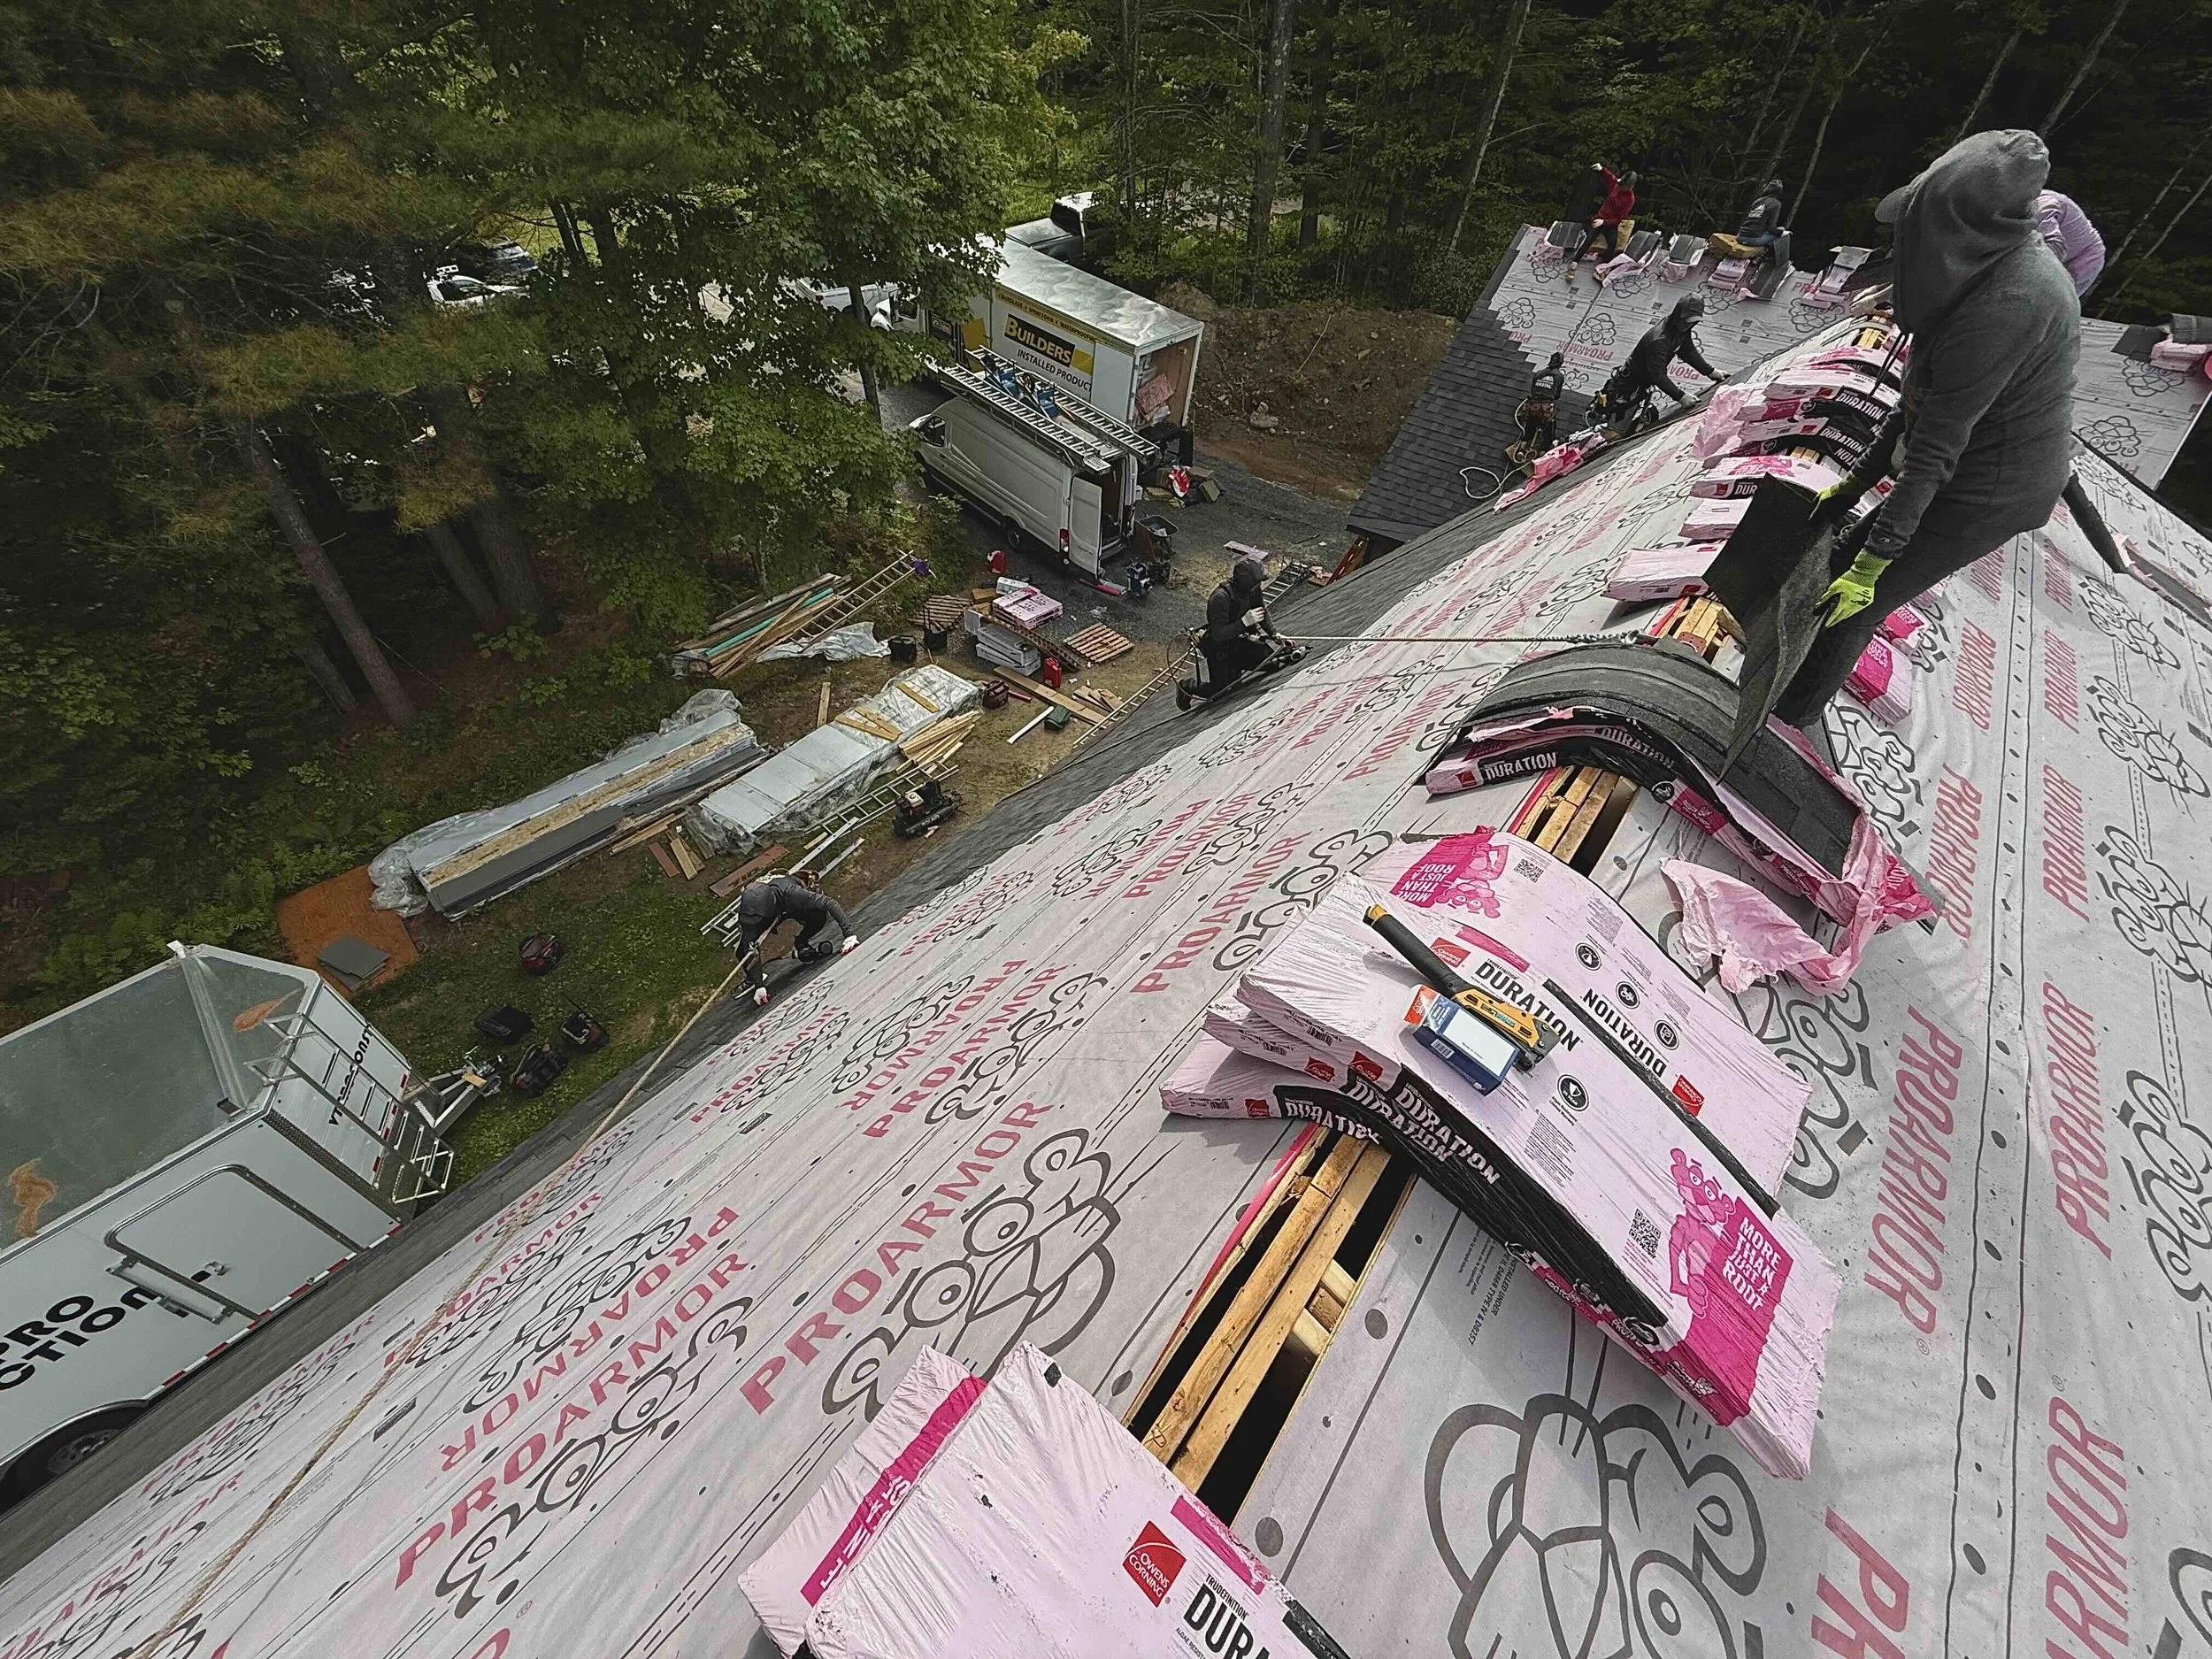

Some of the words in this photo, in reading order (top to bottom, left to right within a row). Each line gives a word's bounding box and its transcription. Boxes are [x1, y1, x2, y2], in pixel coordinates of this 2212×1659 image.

[1007, 317, 1072, 365] BUILDERS
[1018, 349, 1056, 373] INSTALLED
[1835, 393, 1886, 421] DURATION
[1402, 881, 1440, 892] THAN
[1417, 864, 1456, 873] ROOF
[1428, 872, 1447, 882] JUST
[1132, 832, 1311, 994] PROARMOR
[1396, 892, 1432, 902] MORE
[1475, 961, 1580, 1052] DURATION
[1582, 987, 1668, 1079] DURATION
[841, 960, 1026, 1111] PROARMOR
[862, 965, 1069, 1138] PROARMOR
[1345, 1081, 1454, 1162] DURATION
[1394, 1087, 1502, 1185] DURATION
[2043, 982, 2112, 1261] PROARMOR
[1863, 1004, 1963, 1333] PROARMOR
[740, 1100, 1054, 1415] PROARMOR
[1737, 1233, 1775, 1289] THAN
[1740, 1217, 1782, 1270] MORE
[1483, 1287, 1496, 1307] TYPE
[1491, 1291, 1505, 1317] UNDER
[1722, 1262, 1764, 1311] ROOF
[441, 1206, 740, 1471] PROARMOR
[395, 1253, 748, 1590] PROARMOR
[2046, 1396, 2129, 1659] RMOR
[1129, 1554, 1165, 1599] CORNING
[1140, 1552, 1171, 1590] OWENS
[1206, 1574, 1248, 1621] TRUDEFINITION
